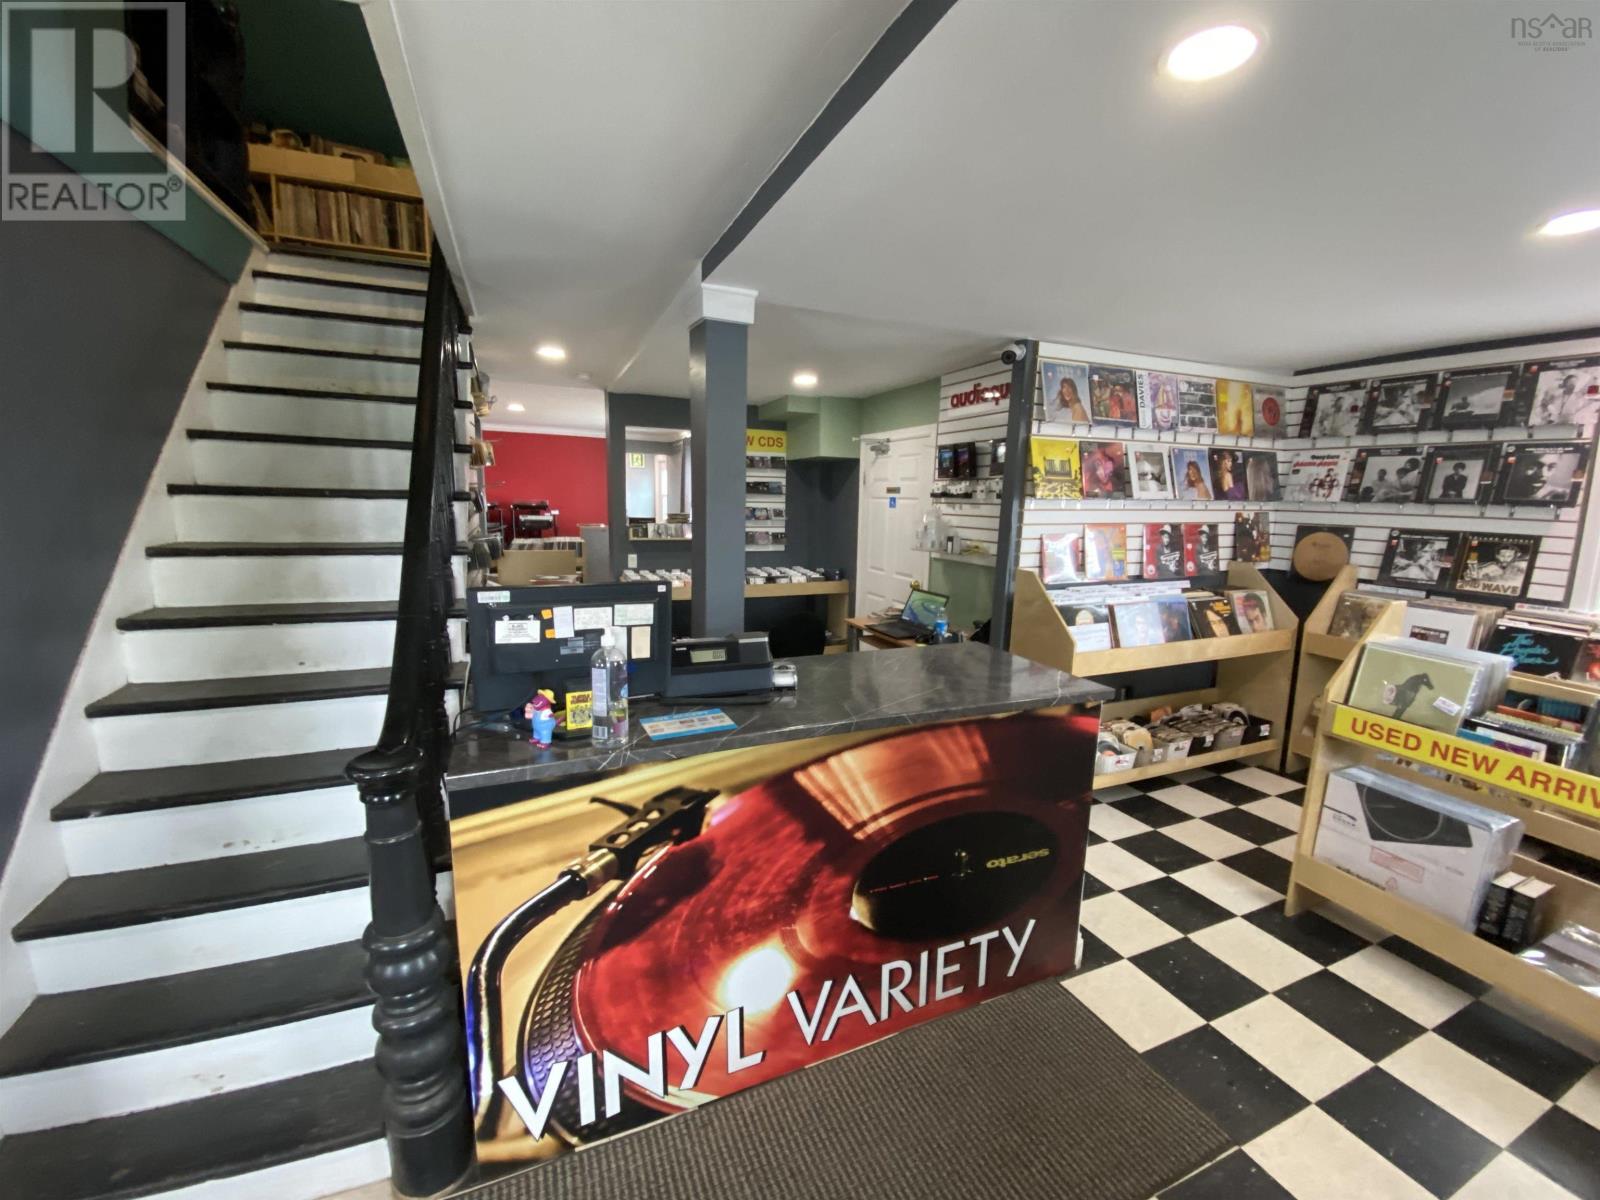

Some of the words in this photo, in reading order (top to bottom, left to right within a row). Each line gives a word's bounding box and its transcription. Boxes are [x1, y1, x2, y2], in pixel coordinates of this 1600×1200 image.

[758, 436, 784, 448] CDS
[1481, 582, 1520, 595] WAVE
[1351, 717, 1422, 751] USED
[1429, 740, 1500, 775] NEW
[986, 848, 1050, 869] serato
[498, 1006, 765, 1142] VINYL
[786, 919, 1037, 1045] VARIETY
